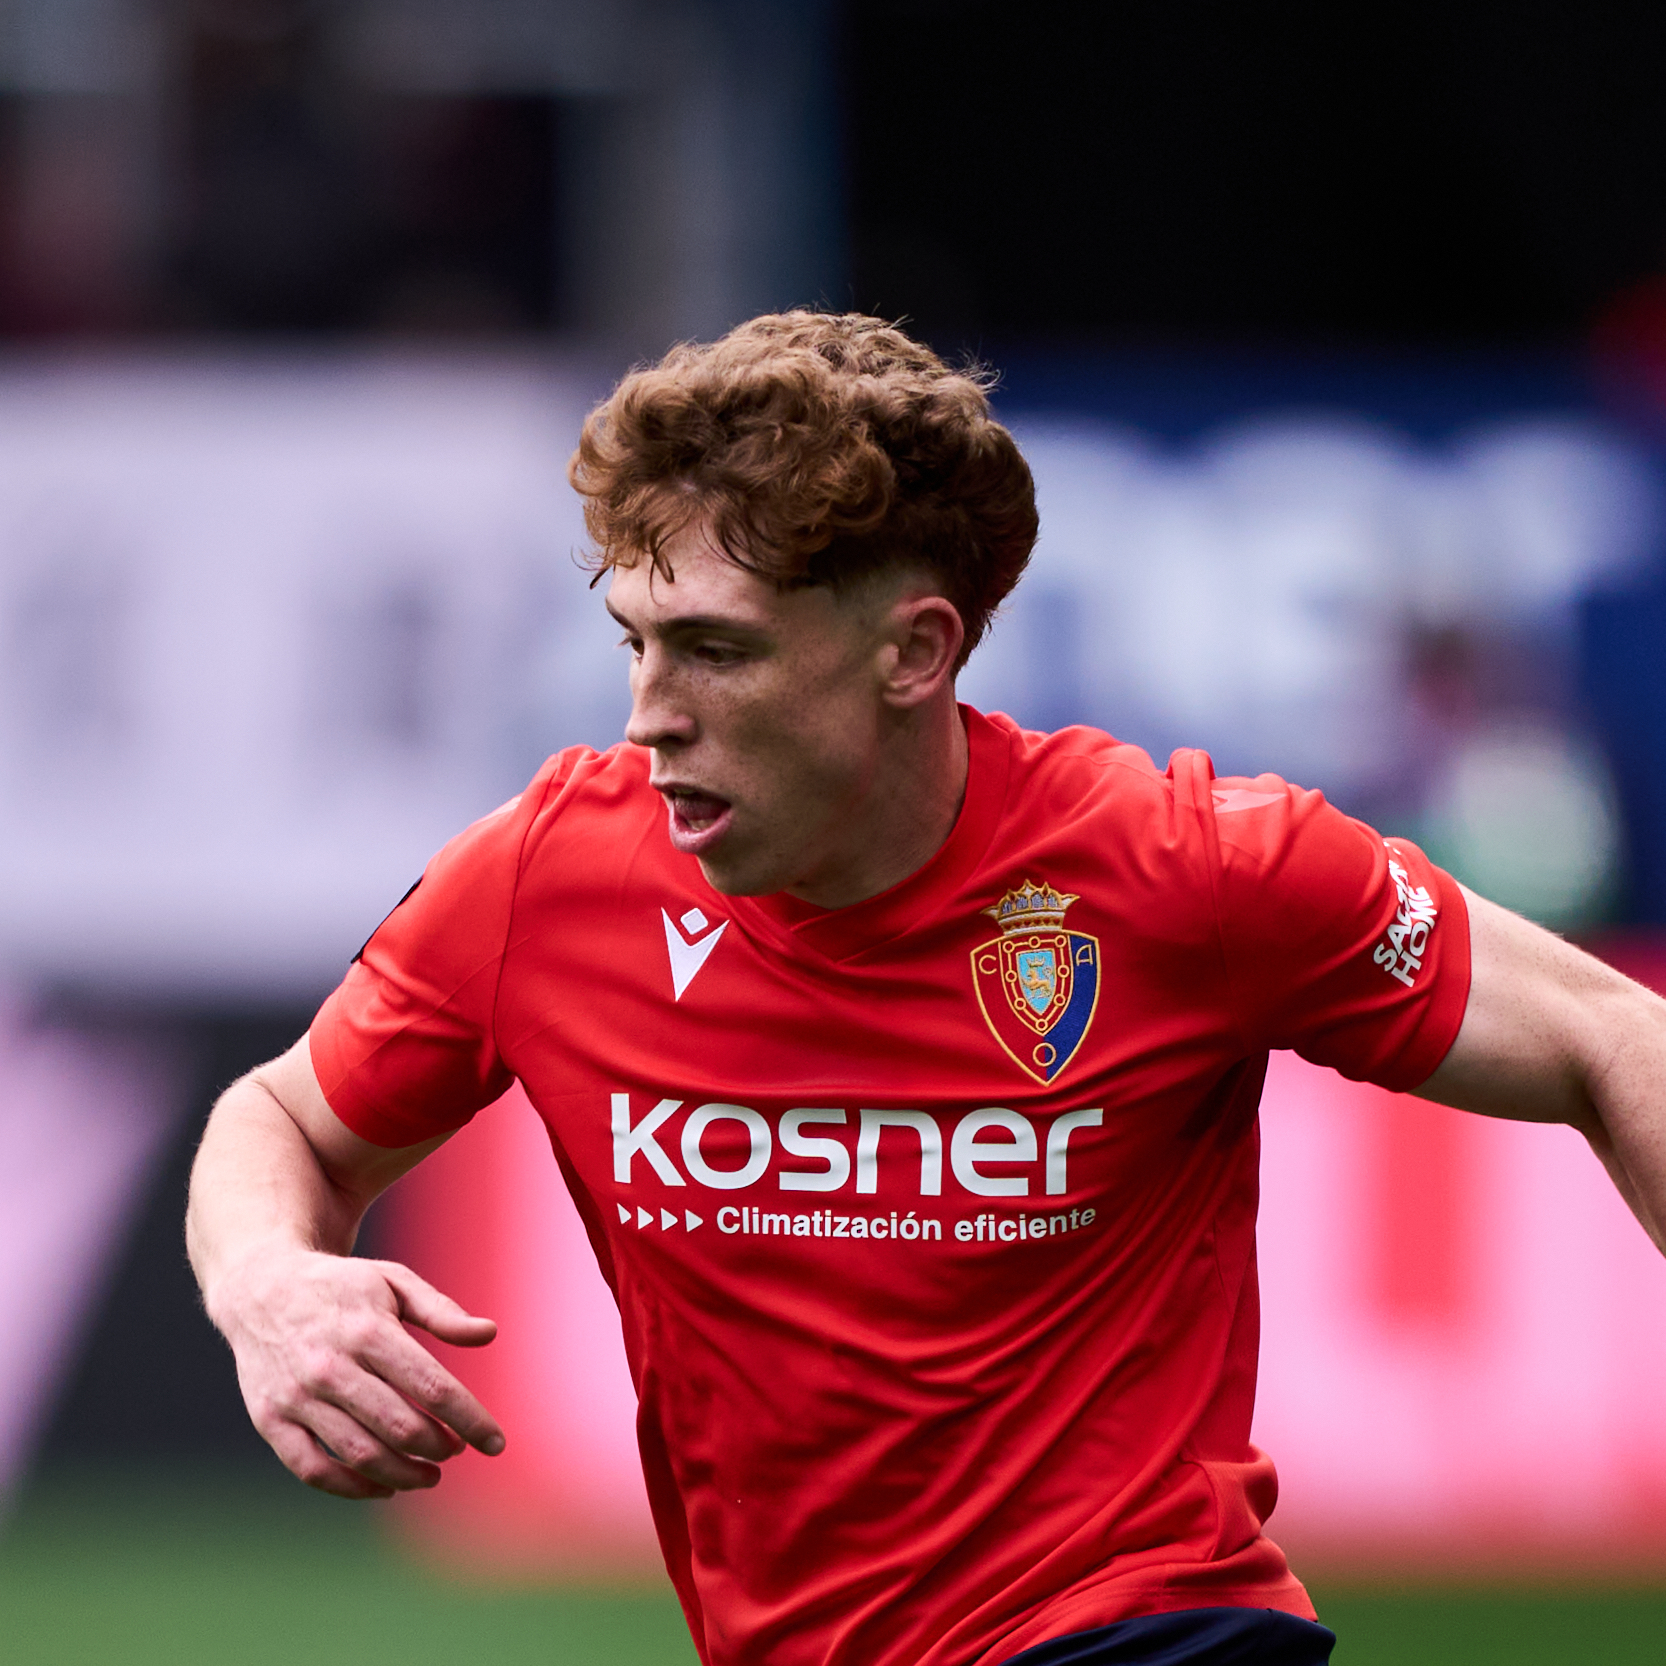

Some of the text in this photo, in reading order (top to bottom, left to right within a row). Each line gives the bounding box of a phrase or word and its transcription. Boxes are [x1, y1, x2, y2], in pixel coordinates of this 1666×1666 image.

[1391, 886, 1437, 988] HOME
[716, 1206, 1096, 1242] Climatización eficiente
